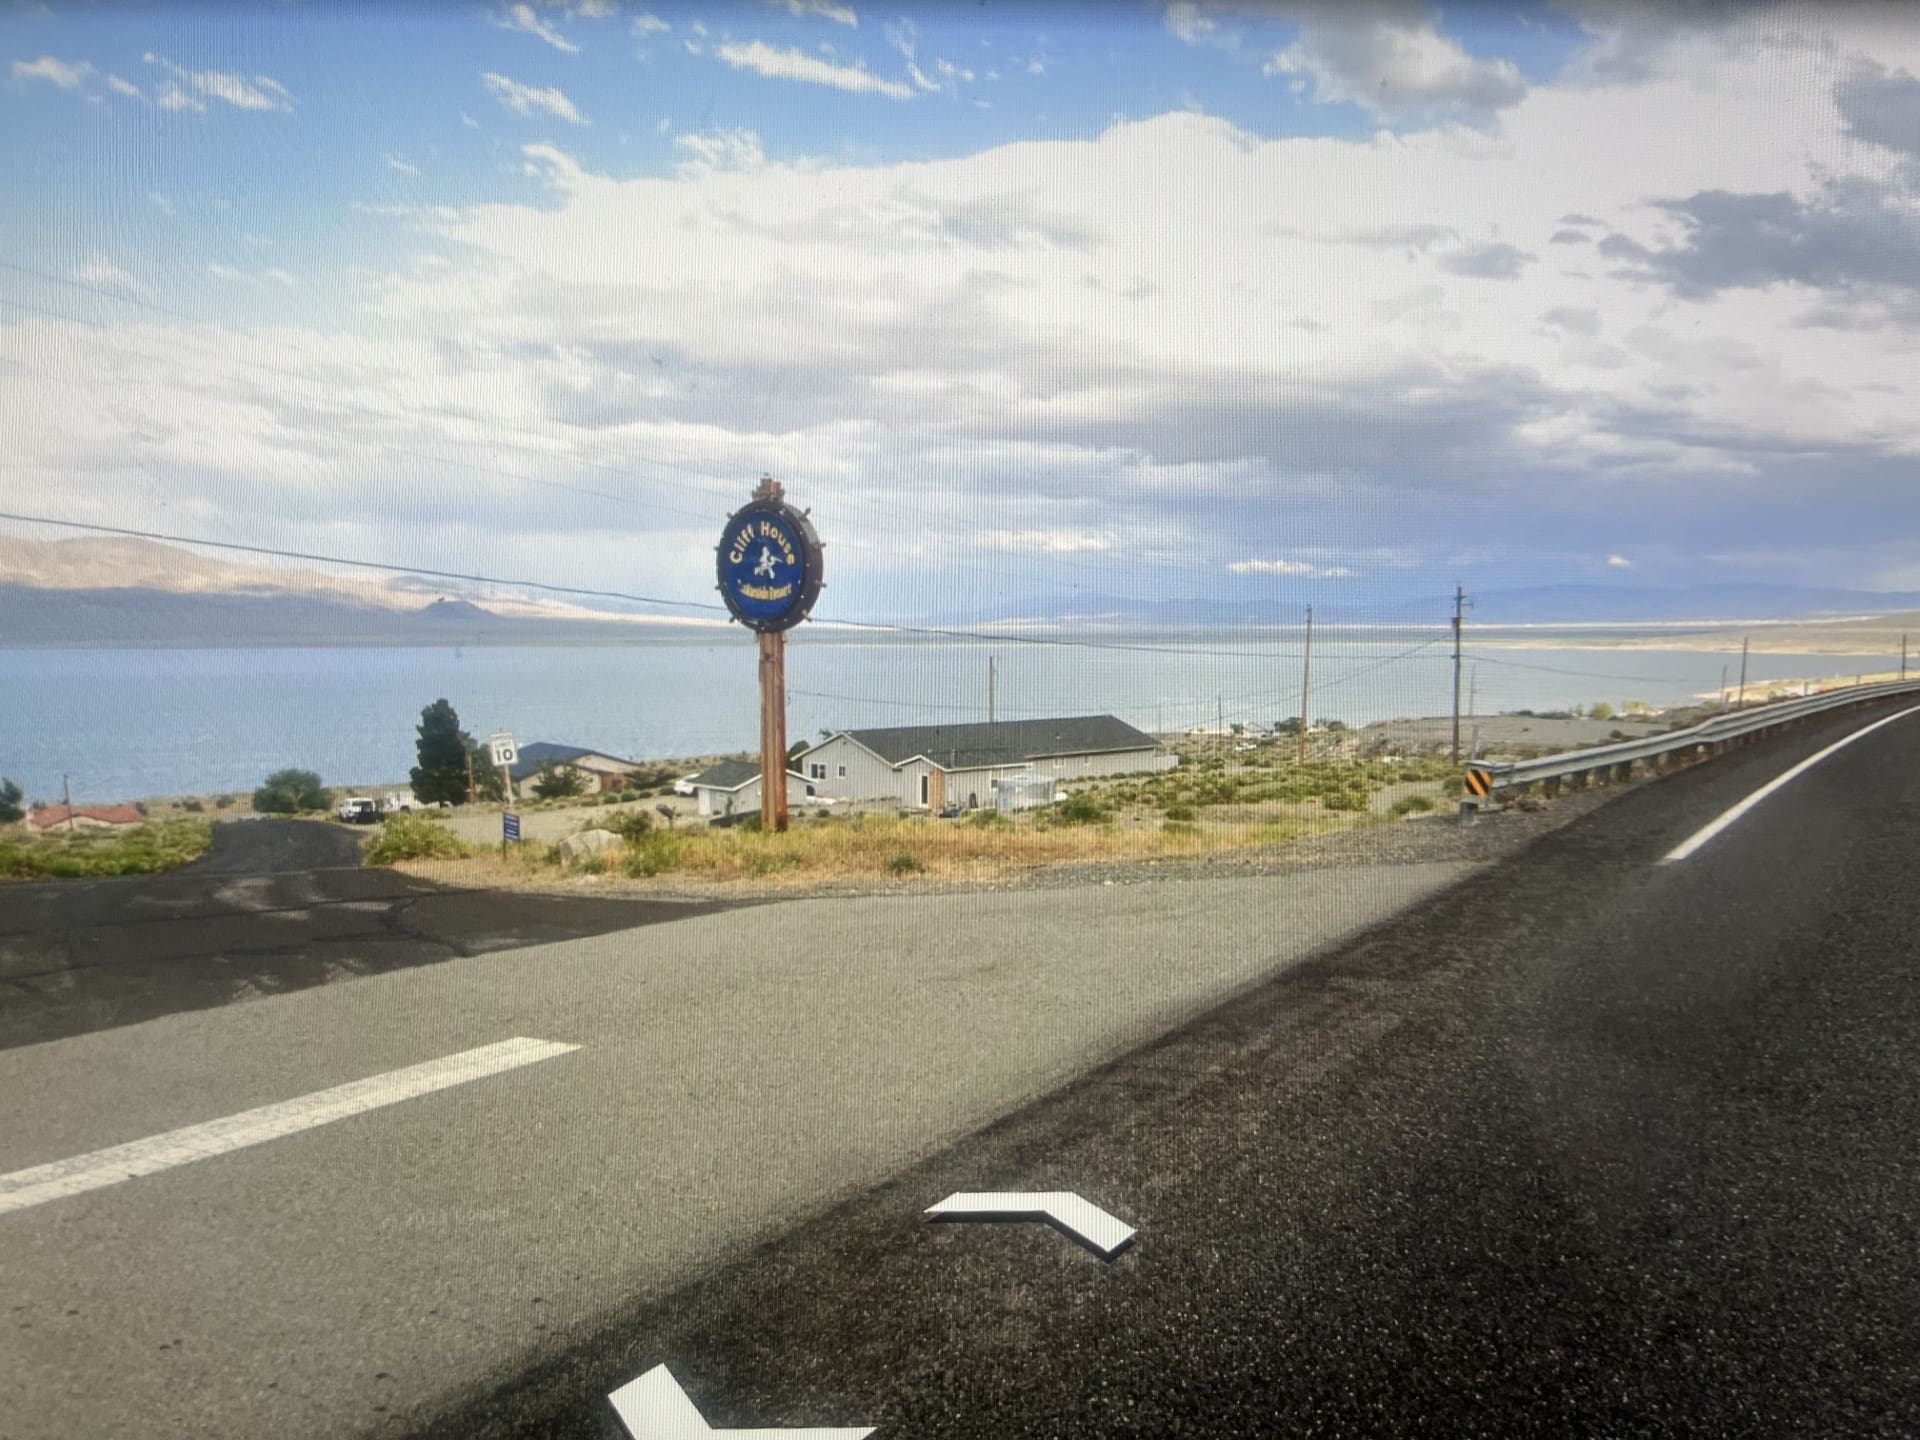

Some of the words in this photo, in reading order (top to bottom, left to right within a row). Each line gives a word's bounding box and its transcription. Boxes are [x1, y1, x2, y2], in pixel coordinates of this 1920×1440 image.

[730, 523, 755, 564] Cliff
[760, 520, 795, 565] House
[496, 748, 513, 762] 10
